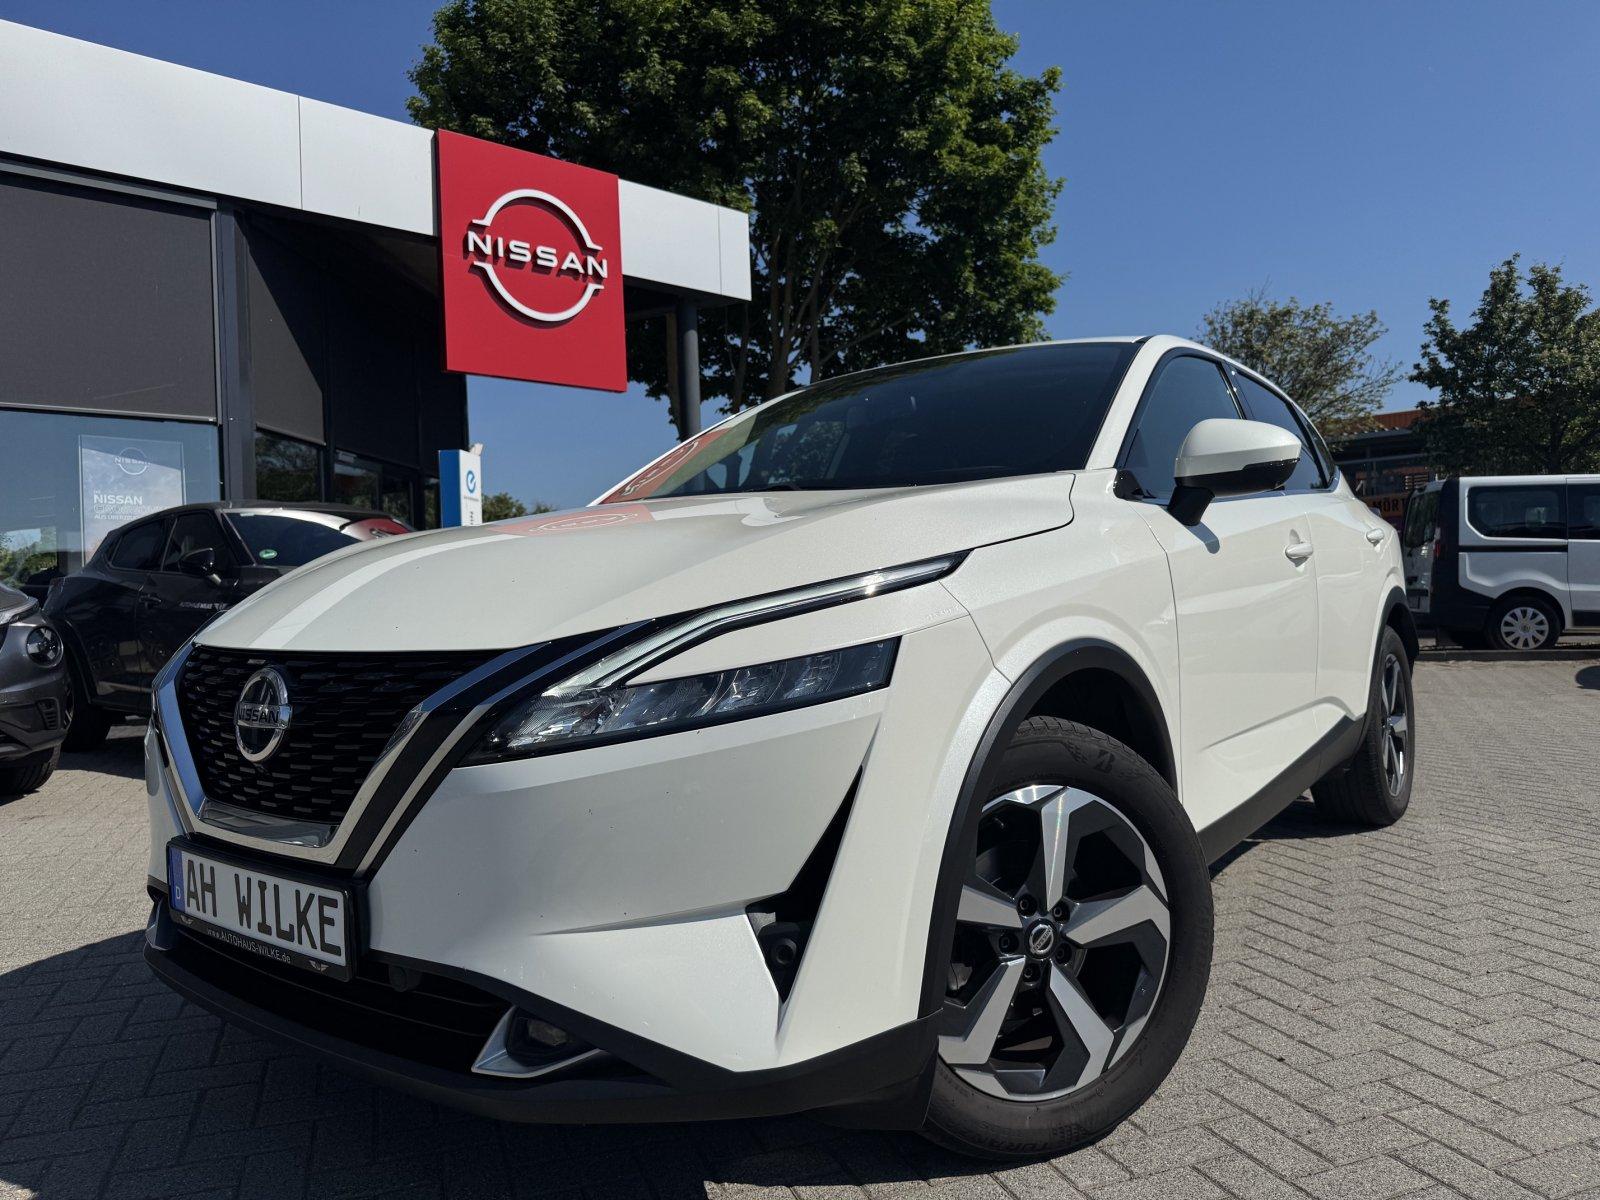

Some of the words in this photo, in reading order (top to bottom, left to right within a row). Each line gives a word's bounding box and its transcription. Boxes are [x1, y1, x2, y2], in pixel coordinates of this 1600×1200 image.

[467, 230, 608, 278] NISSAN
[93, 494, 143, 505] NISSAN
[237, 706, 280, 723] NISSAN
[175, 886, 181, 900] D
[187, 859, 217, 917] AH
[234, 873, 342, 957] WILKE
